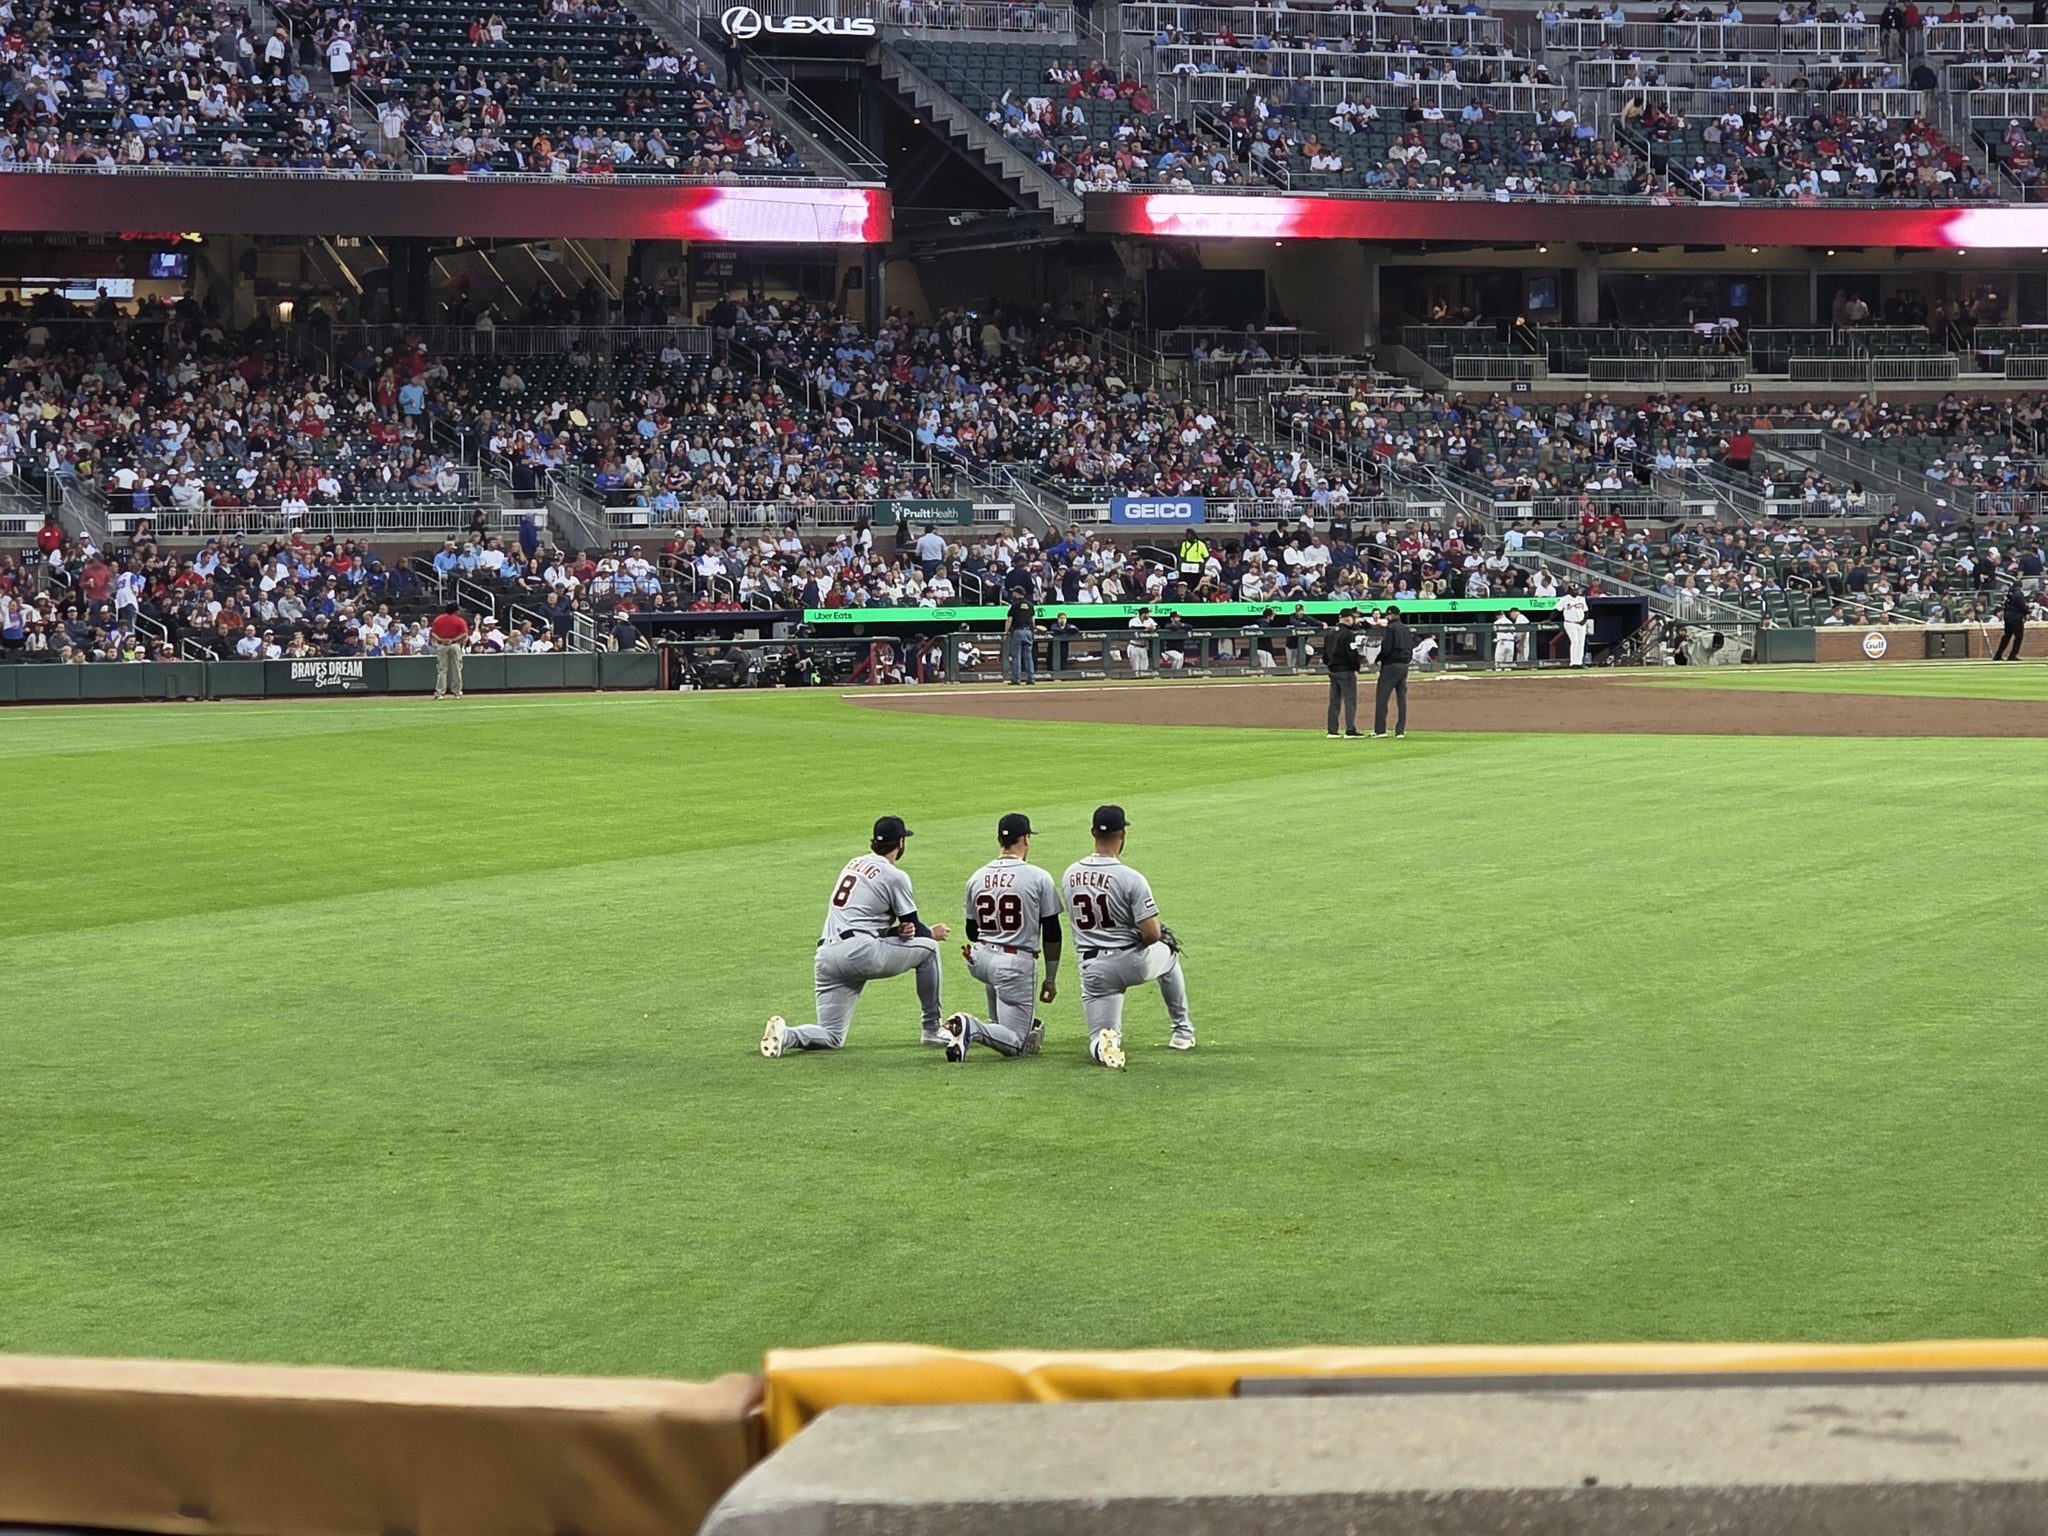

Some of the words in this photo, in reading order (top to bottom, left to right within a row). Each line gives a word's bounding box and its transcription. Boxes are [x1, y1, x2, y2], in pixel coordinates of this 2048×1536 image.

[764, 15, 876, 36] LEXUS
[1733, 384, 1749, 393] 123
[903, 507, 959, 519] PruittHealth
[1124, 503, 1192, 519] GEICO
[814, 612, 833, 620] Uber
[833, 611, 852, 620] Eats
[1865, 641, 1885, 650] Gulf
[291, 662, 328, 680] BRAVES
[329, 661, 363, 678] DREAM
[984, 868, 1016, 889] BÁEZ
[1069, 871, 1112, 890] GREENE
[832, 873, 858, 909] 8
[975, 893, 1024, 932] 28
[1072, 892, 1117, 931] 31
